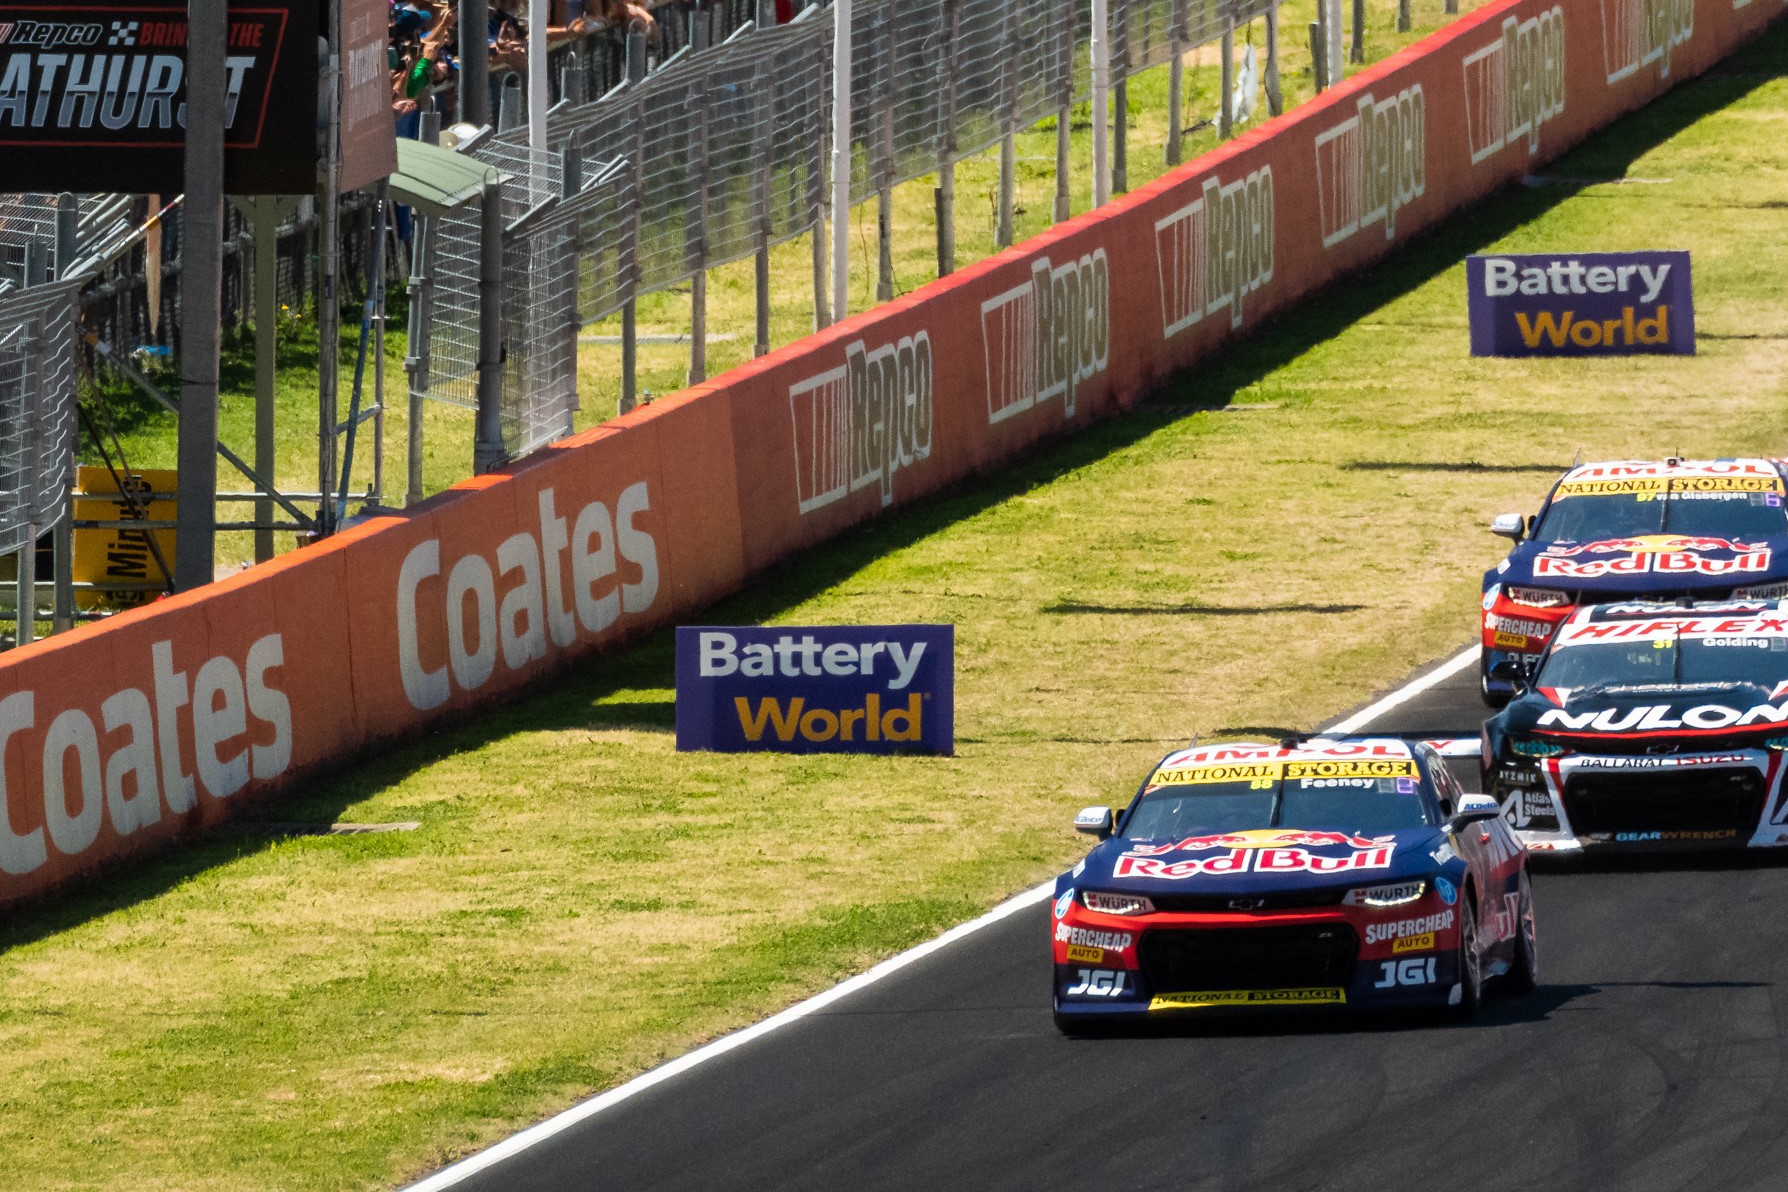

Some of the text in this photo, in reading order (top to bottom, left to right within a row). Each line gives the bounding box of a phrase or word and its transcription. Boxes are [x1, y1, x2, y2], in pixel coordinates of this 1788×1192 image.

[10, 20, 264, 49] Repco BRIN THE
[0, 52, 257, 131] ATHURT
[1357, 84, 1426, 241] Repco
[1203, 165, 1275, 329] Repco
[1483, 258, 1672, 304] Battery
[1031, 248, 1111, 418] Repco
[1514, 304, 1669, 349] World
[847, 330, 934, 507] Repco
[1572, 462, 1774, 480] AMPOL
[1561, 477, 1775, 495] NATIONAL STORAGE
[1635, 492, 1748, 503] 97 Gisbergen
[1534, 548, 1772, 577] Red Bull
[397, 481, 662, 711] Coates
[1484, 615, 1552, 640] SUPERCHEAP
[1652, 637, 1769, 650] 31 Golding
[699, 631, 929, 691] Battery
[733, 691, 923, 743] World
[0, 632, 294, 876] Coates
[1168, 742, 1407, 767] AMPOL
[1580, 753, 1746, 769] BALLARAT ISUZU
[1156, 761, 1408, 784] NATIONAL STORAGE
[1249, 777, 1376, 791] 88 Feeney
[1463, 801, 1499, 811] ACDelco
[1524, 791, 1552, 805] Atlas
[1524, 804, 1557, 818] Steels
[1615, 829, 1738, 842] GEARWRENCH
[1113, 842, 1398, 880] Red Bull
[1098, 894, 1148, 912] WÜRTH
[1368, 884, 1424, 902] WÜRTH
[1055, 921, 1132, 954] SUPERCHEAP
[1364, 909, 1455, 946] SUPERCHEAP
[1070, 947, 1101, 960] AUTO
[1397, 936, 1430, 950] AUTO
[1066, 968, 1127, 998] JGI
[1374, 958, 1437, 989] JGI
[1156, 988, 1338, 1005] NATIONAL STORAGE
